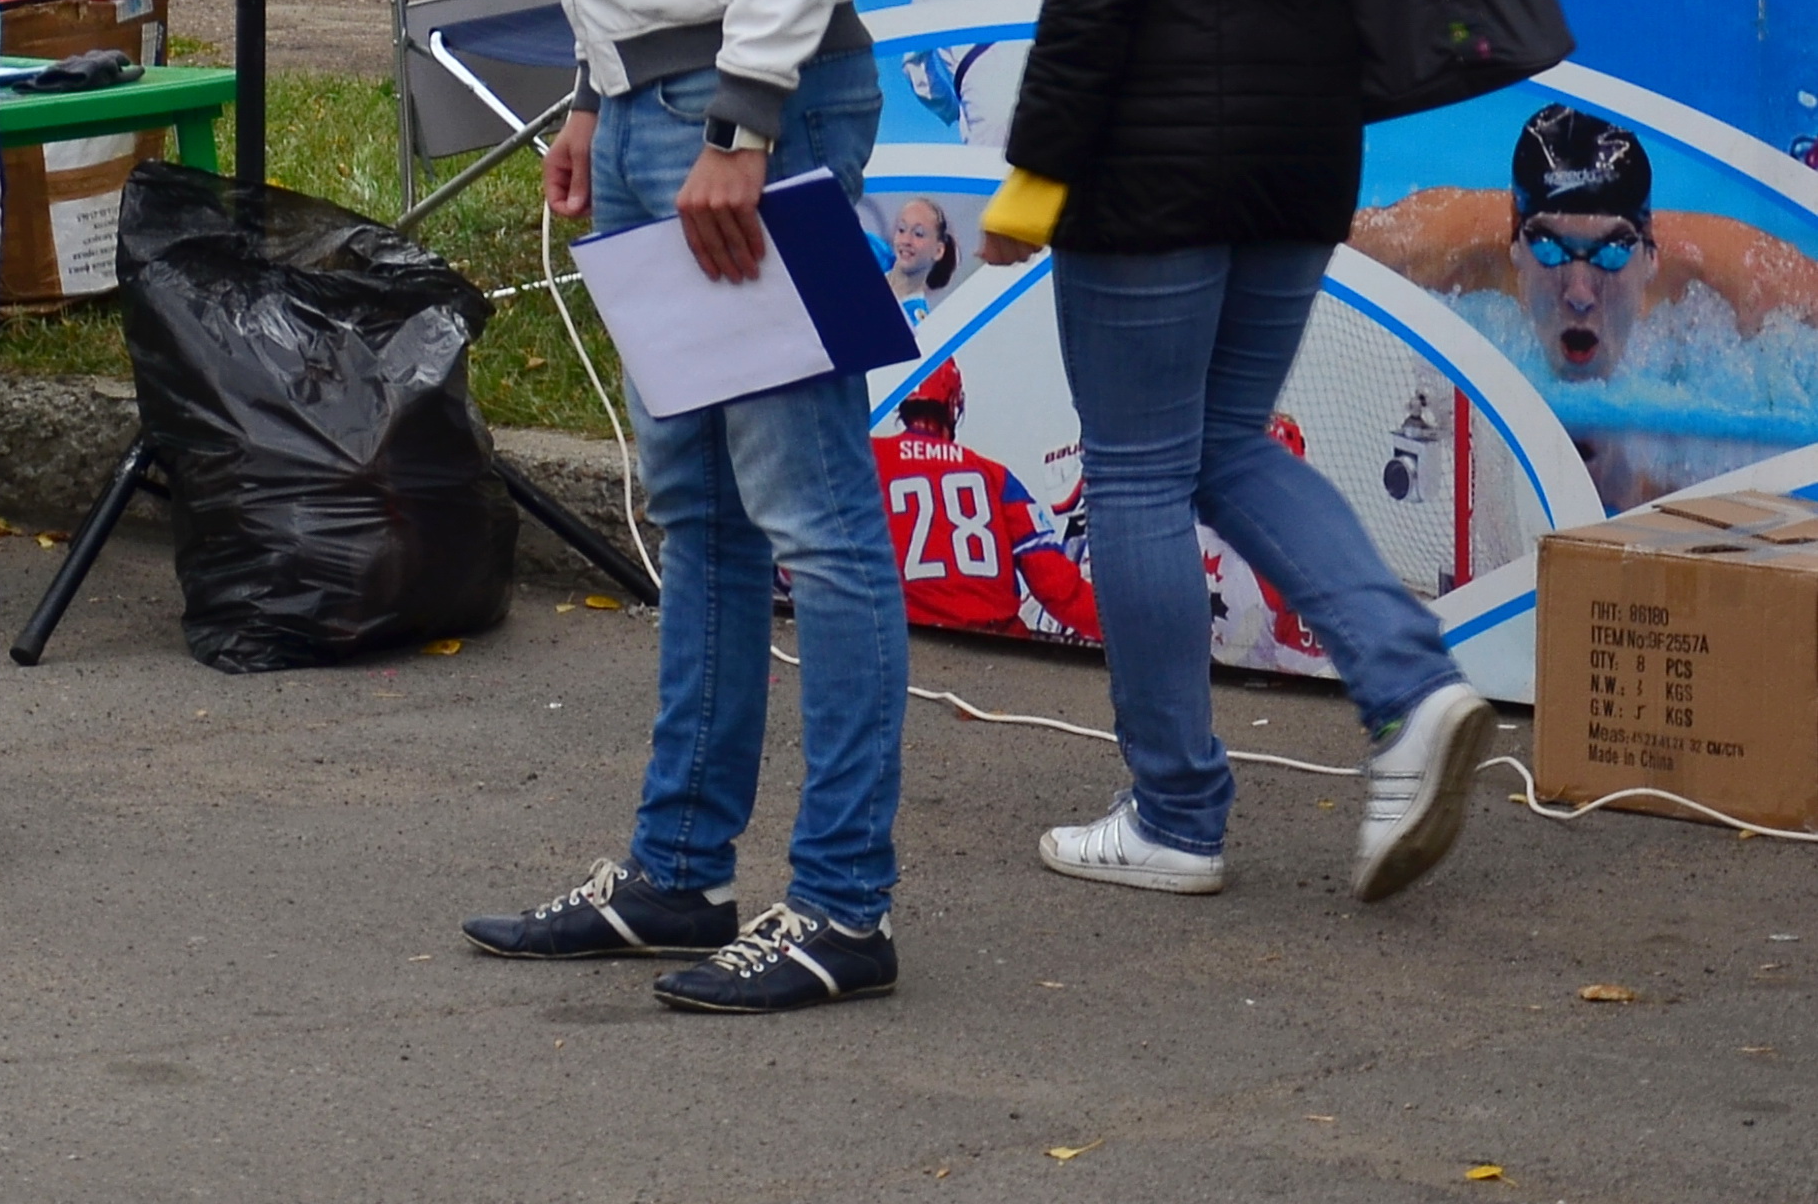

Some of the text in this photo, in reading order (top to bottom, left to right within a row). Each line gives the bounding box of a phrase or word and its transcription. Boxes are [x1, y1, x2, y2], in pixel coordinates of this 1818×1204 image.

[899, 441, 964, 462] SEMIN
[888, 471, 1000, 582] 28
[1591, 625, 1624, 647] ITEM
[1636, 654, 1645, 673] 8
[1665, 657, 1693, 679] PCS
[1665, 682, 1693, 702] KGS
[1665, 706, 1693, 728] KGS
[1588, 744, 1674, 771] Made in China
